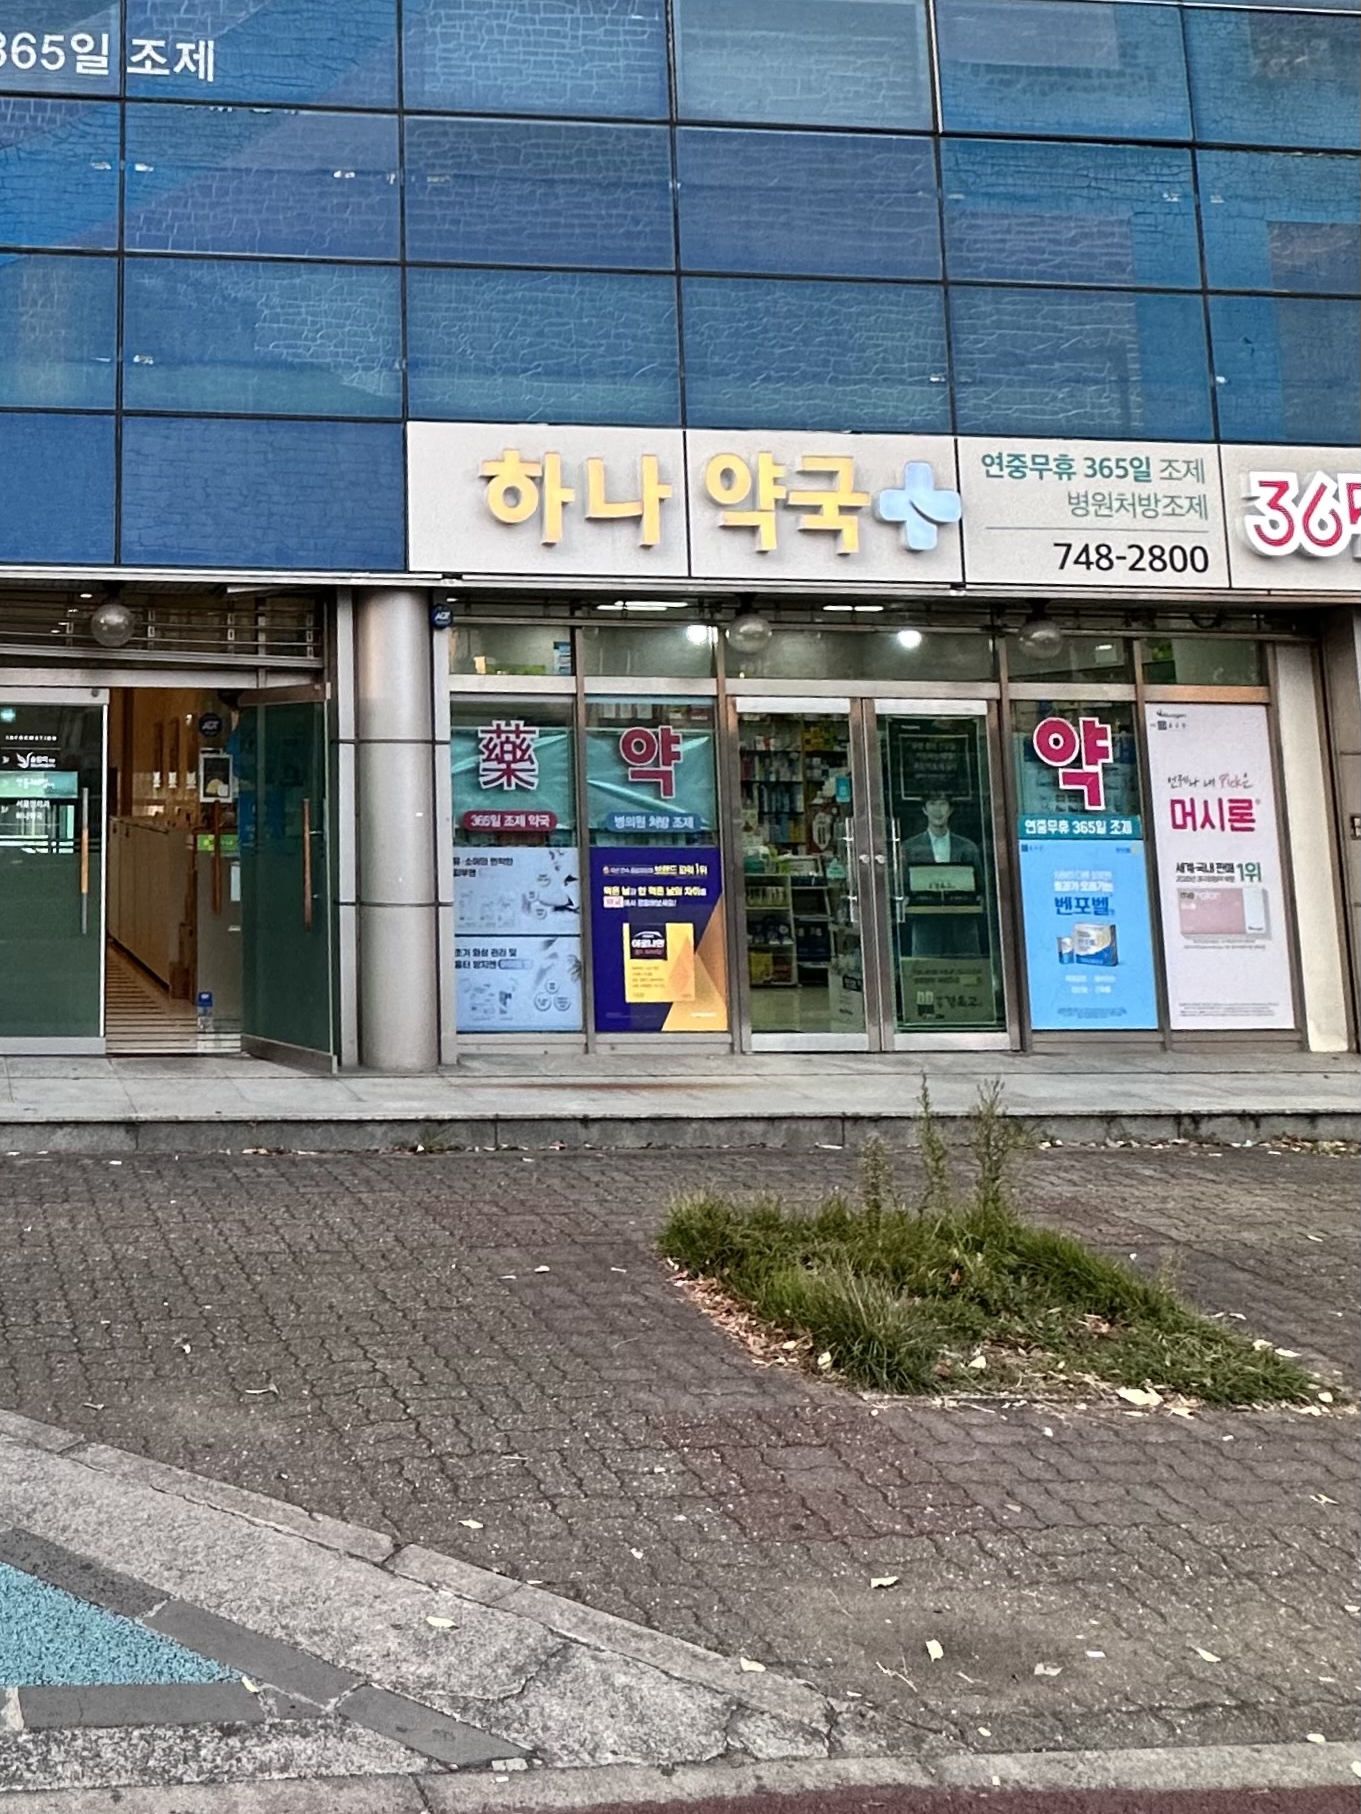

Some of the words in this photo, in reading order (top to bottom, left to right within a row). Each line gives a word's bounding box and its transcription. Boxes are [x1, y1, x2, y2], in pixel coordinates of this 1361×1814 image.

[126, 38, 216, 82] 조제
[980, 452, 1077, 481] 연중무휴
[1083, 455, 1153, 484] 365일
[1158, 457, 1207, 485] 조제
[1067, 491, 1210, 521] 병원처방조제
[1052, 542, 1210, 574] 748-2800
[479, 720, 539, 790] 藥
[619, 725, 683, 799] 약
[1033, 716, 1114, 810] 약
[528, 814, 551, 827] 약국
[1072, 820, 1107, 834] 365일
[1170, 797, 1257, 833] 머시론
[1235, 862, 1263, 883] 1위
[1054, 897, 1109, 916] 벤포벨
